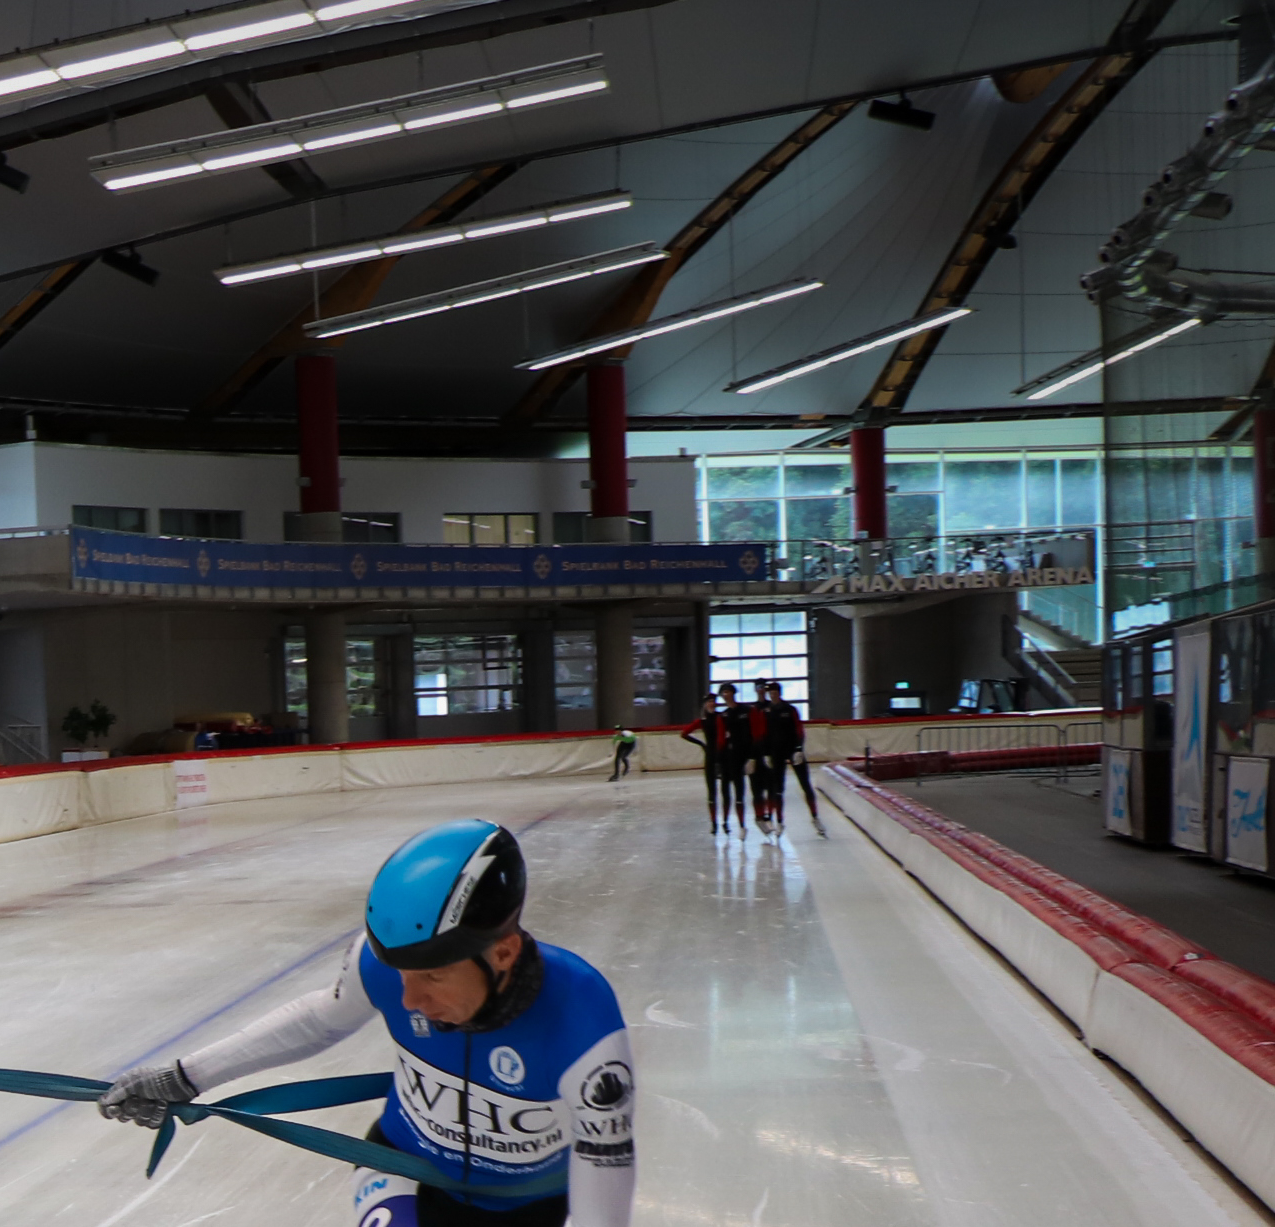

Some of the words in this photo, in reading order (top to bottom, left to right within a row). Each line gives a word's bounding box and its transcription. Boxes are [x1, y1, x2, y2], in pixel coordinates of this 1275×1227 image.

[850, 573, 906, 593] MAX
[914, 569, 1000, 591] AICHER
[1008, 566, 1095, 587] ARENA
[399, 1055, 558, 1135] WHC
[579, 1114, 632, 1136] WH
